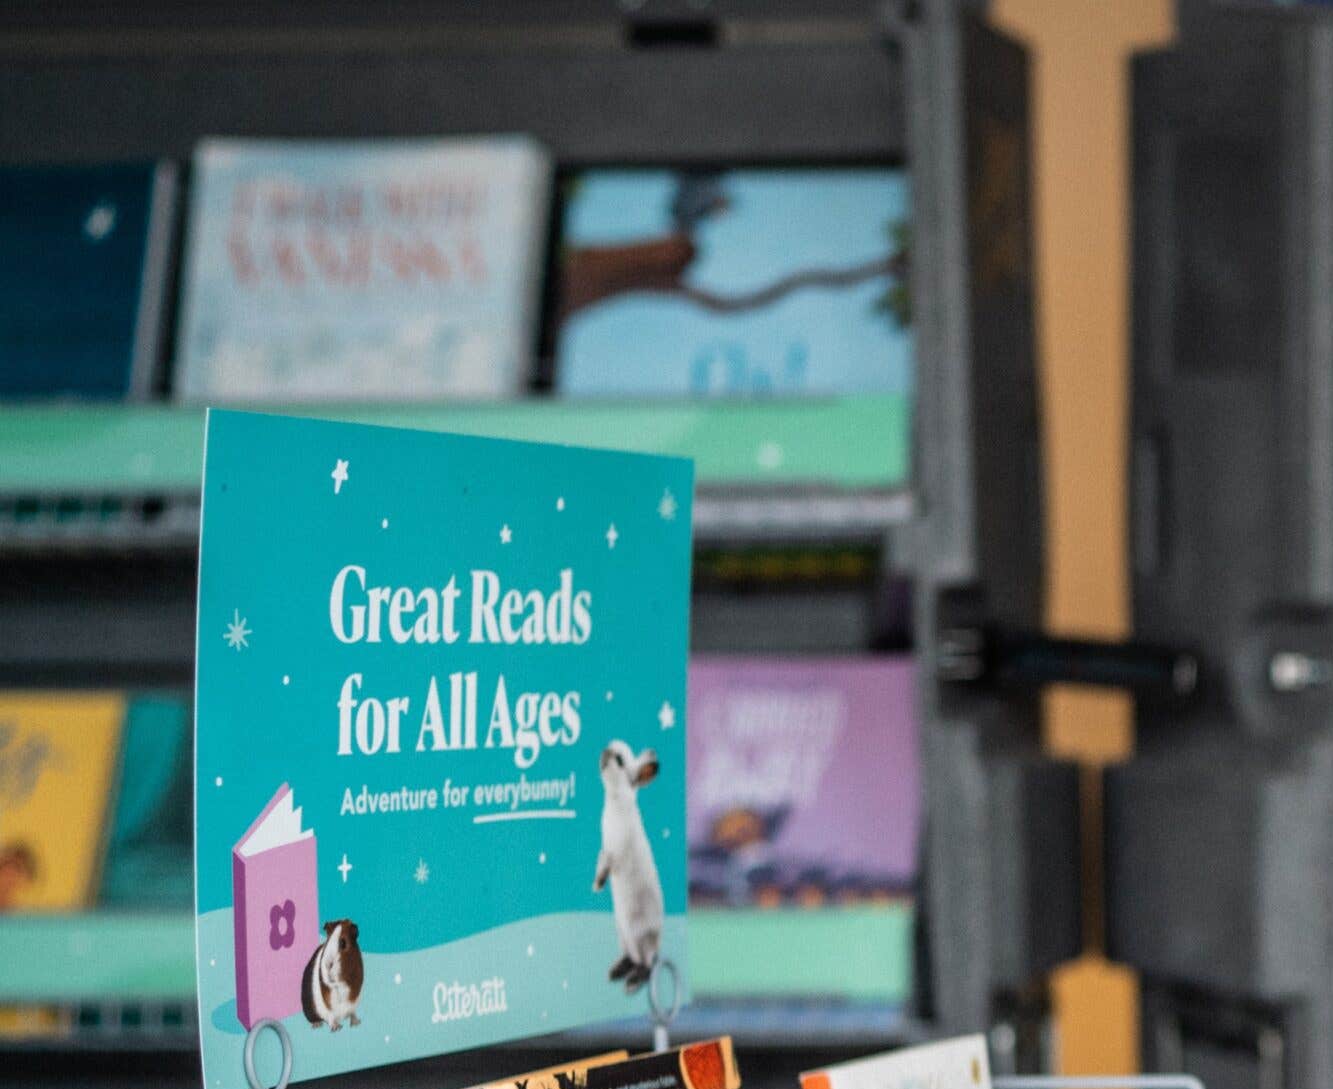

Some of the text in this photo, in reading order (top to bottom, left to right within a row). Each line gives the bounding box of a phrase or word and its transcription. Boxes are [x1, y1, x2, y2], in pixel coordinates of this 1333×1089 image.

[329, 565, 592, 645] Great Reads
[336, 671, 582, 768] for All Ages
[340, 773, 576, 817] Adventure for everybunny!
